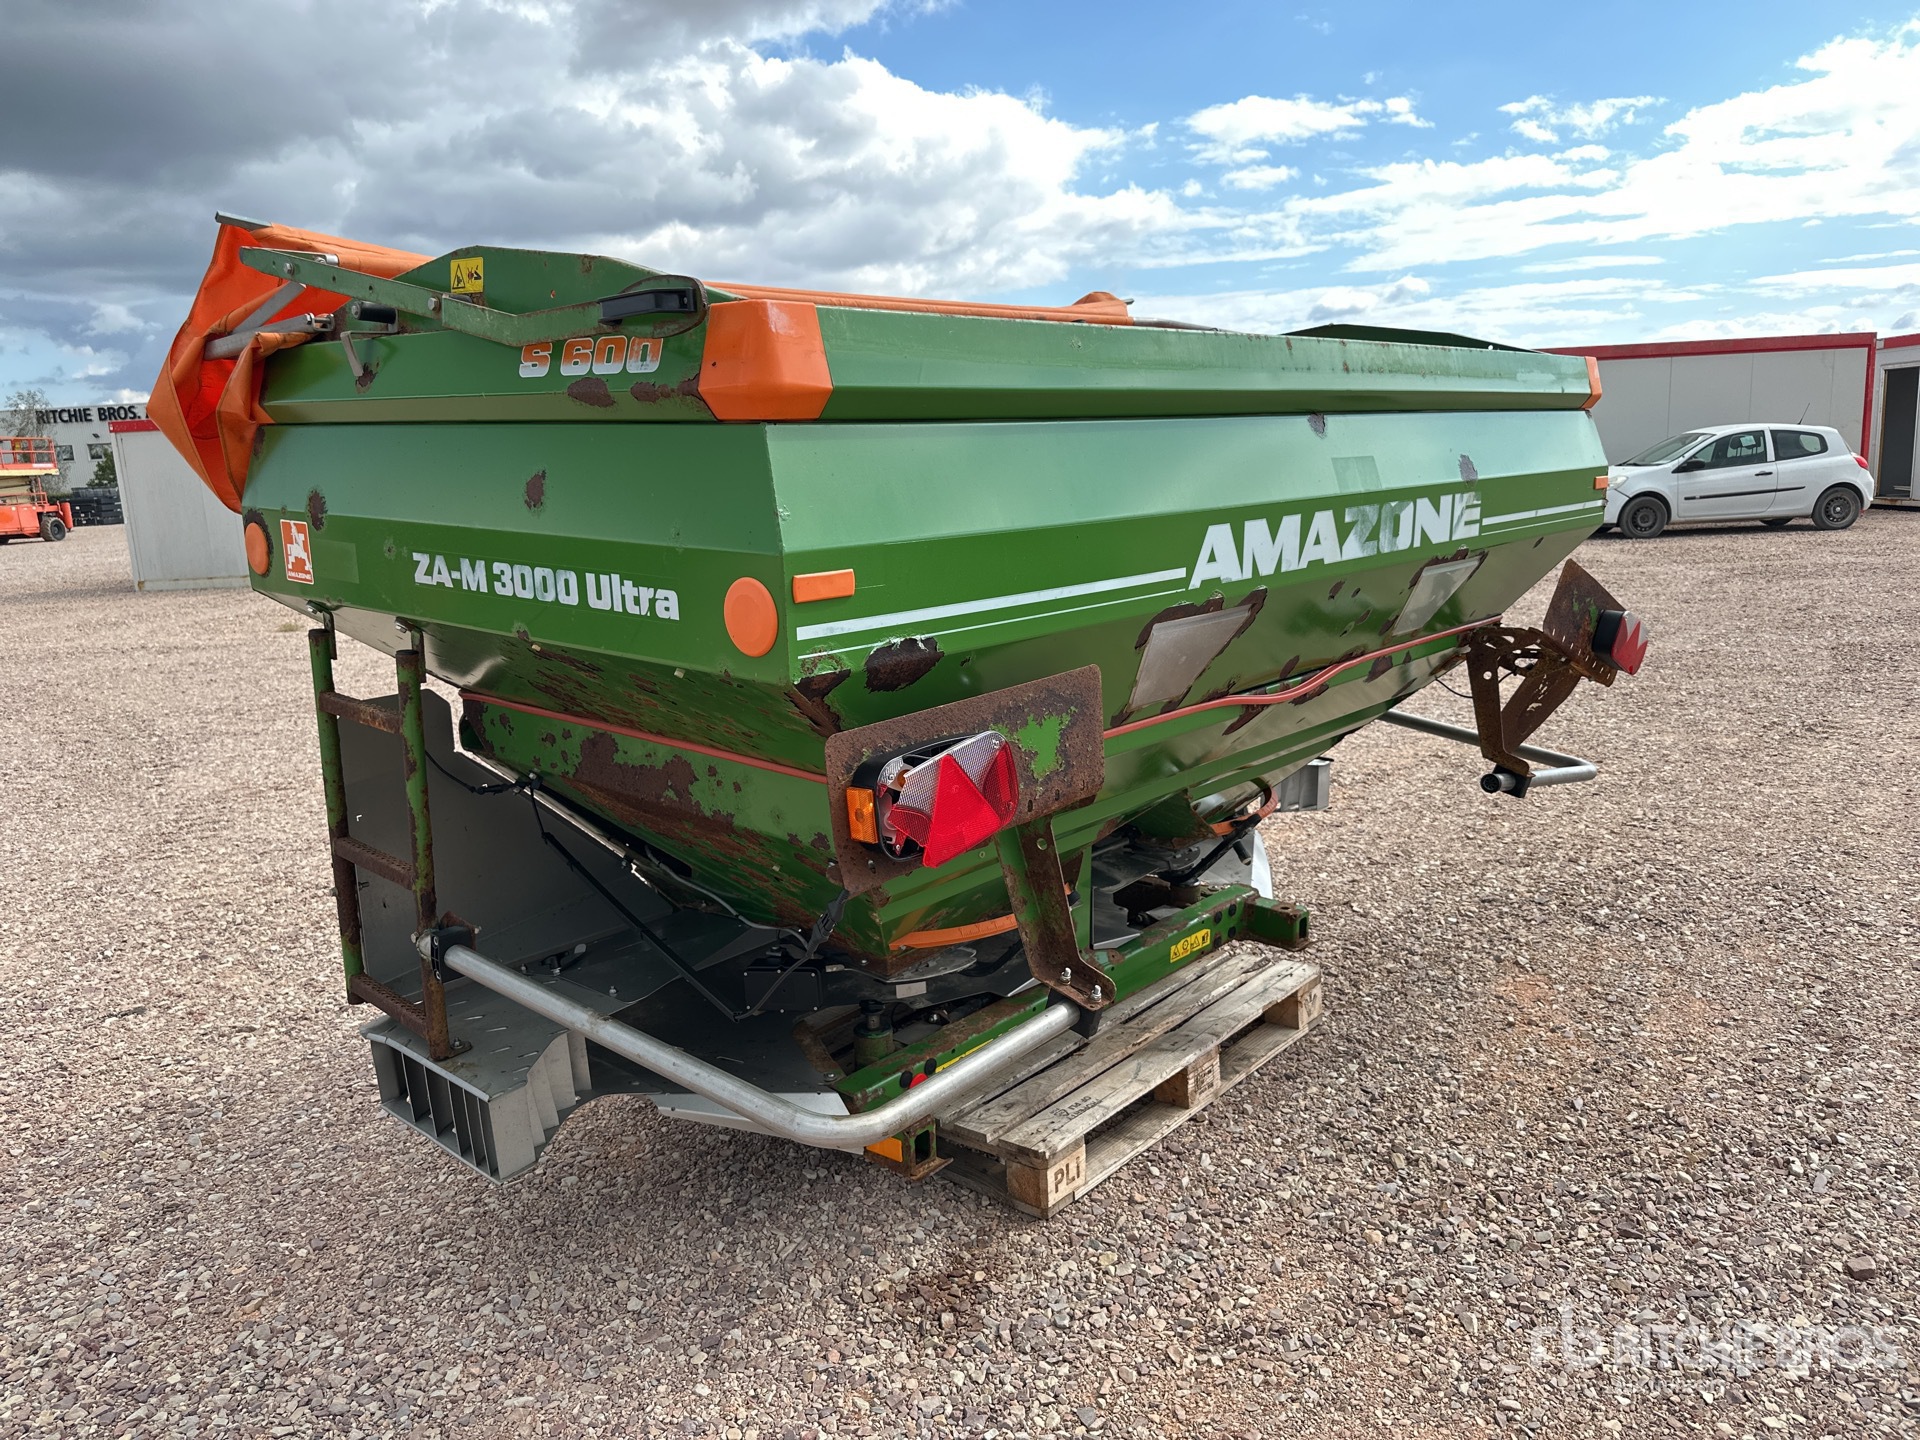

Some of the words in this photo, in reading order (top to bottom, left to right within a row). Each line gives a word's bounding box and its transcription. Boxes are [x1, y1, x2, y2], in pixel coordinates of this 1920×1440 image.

[519, 342, 553, 378] S
[560, 335, 664, 376] 600
[35, 407, 93, 424] RITCHIE
[98, 405, 141, 422] BROS.
[1188, 491, 1482, 590] AMAZONE
[412, 552, 488, 593] ZA-M
[493, 561, 579, 606] 3000
[585, 572, 680, 621] Ultra
